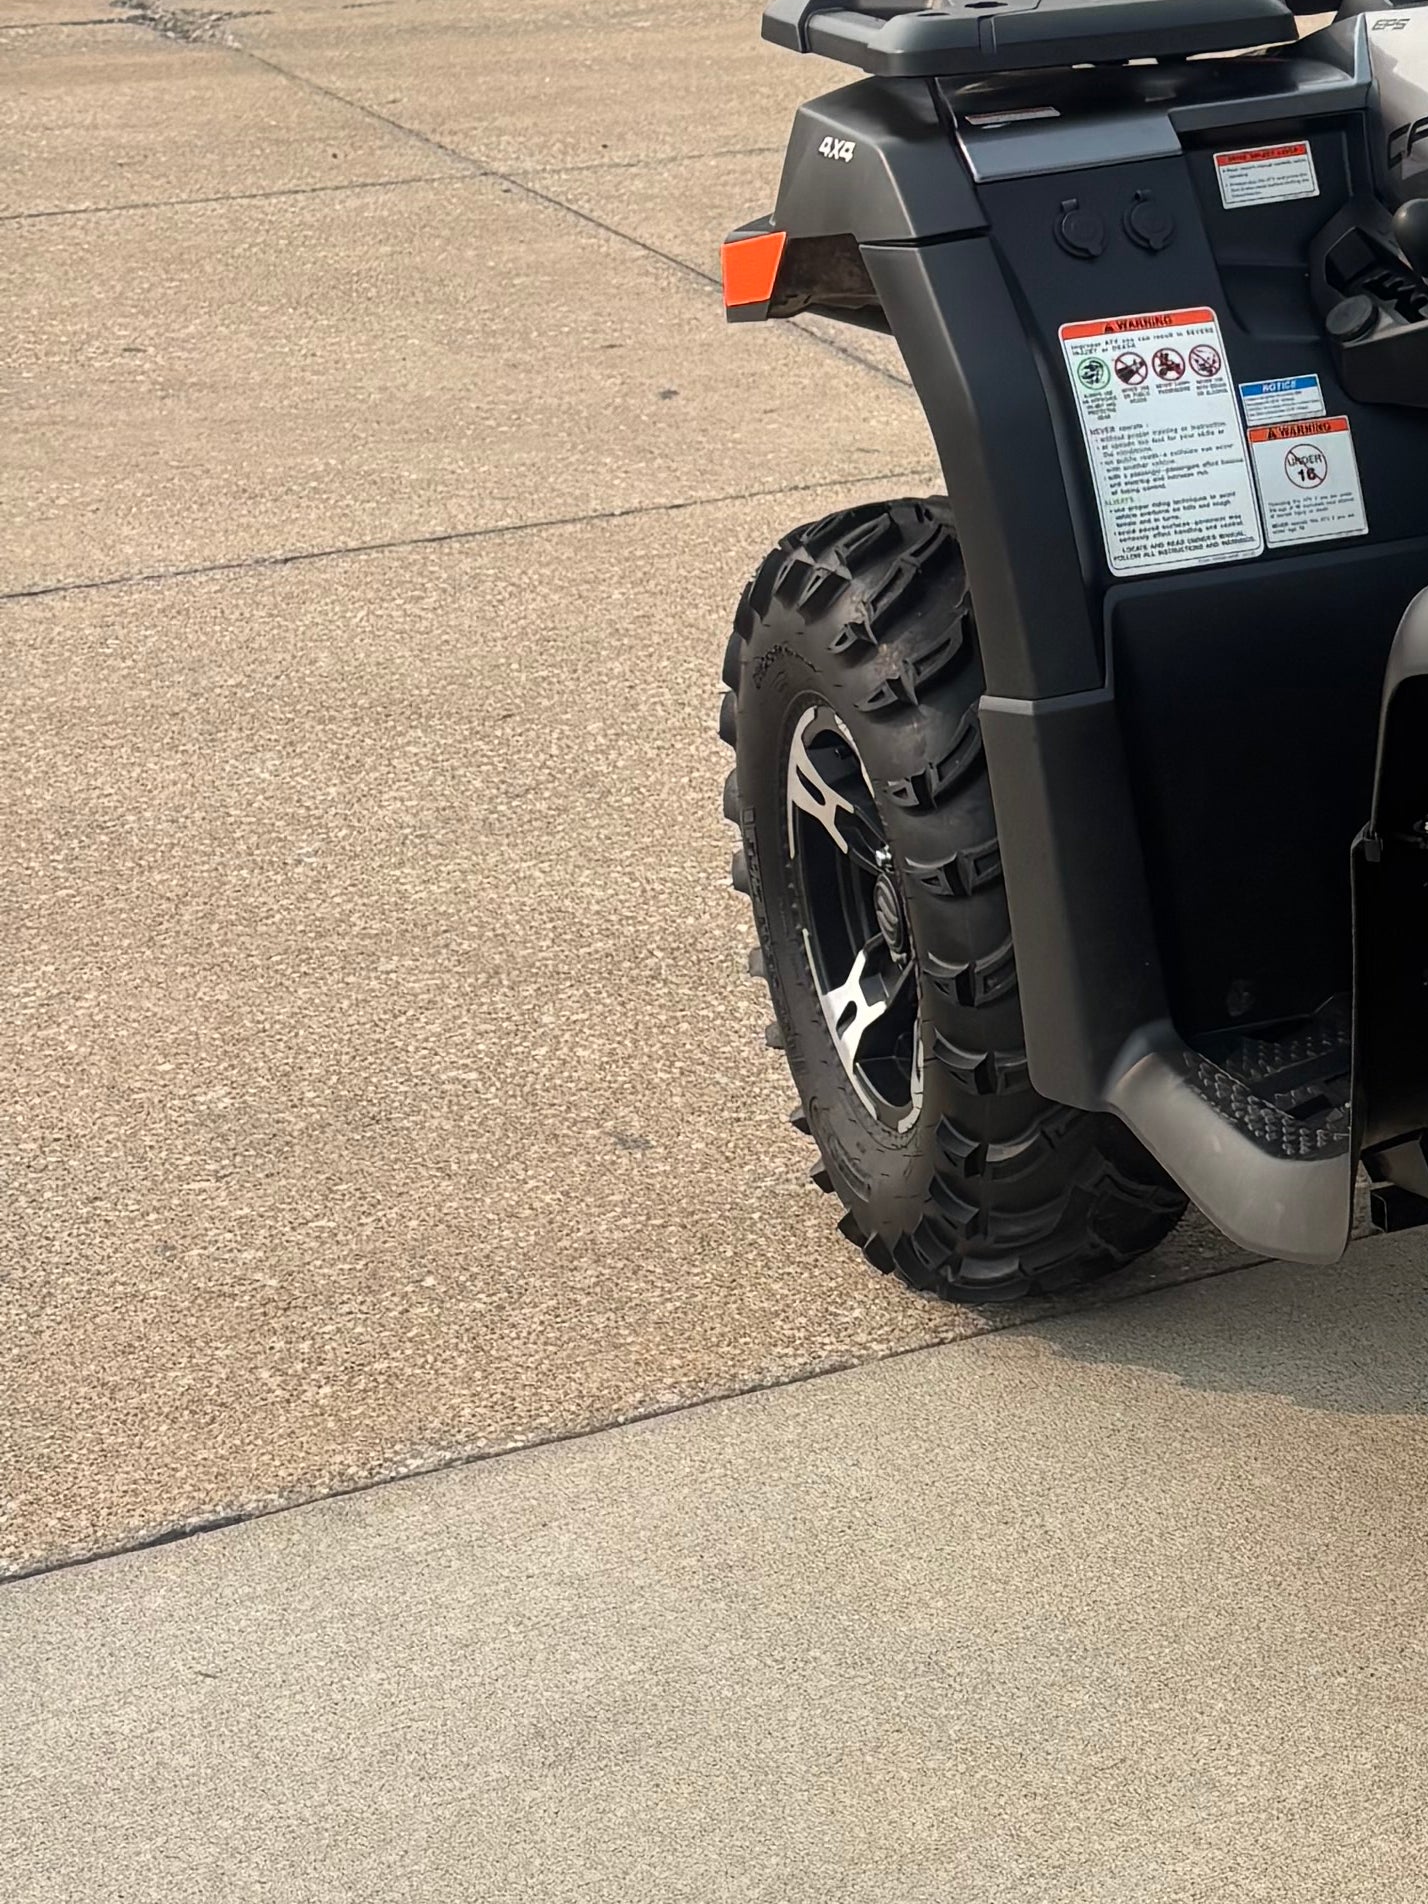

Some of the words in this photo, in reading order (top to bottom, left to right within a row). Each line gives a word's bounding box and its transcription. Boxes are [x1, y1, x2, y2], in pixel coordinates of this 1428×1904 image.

[1371, 18, 1411, 31] EPS
[1116, 314, 1172, 331] WARNING
[1261, 380, 1297, 392] NOTICE
[1277, 420, 1331, 437] WARNING
[1287, 454, 1322, 467] UNDER
